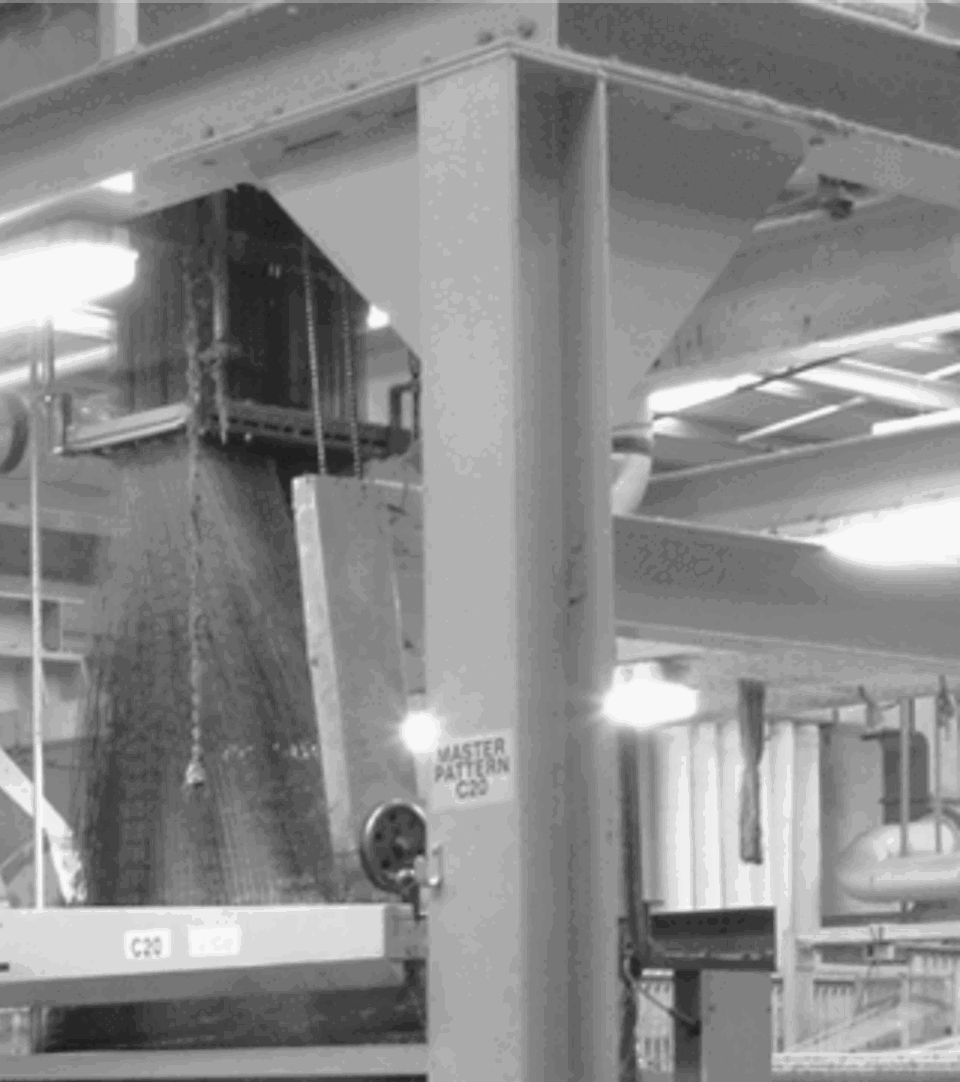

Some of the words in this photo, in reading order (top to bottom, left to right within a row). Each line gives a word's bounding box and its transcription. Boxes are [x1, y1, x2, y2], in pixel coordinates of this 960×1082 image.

[437, 737, 505, 763] MASTER
[434, 756, 510, 784] PATTERN
[455, 778, 489, 799] C20
[130, 936, 162, 958] C20
